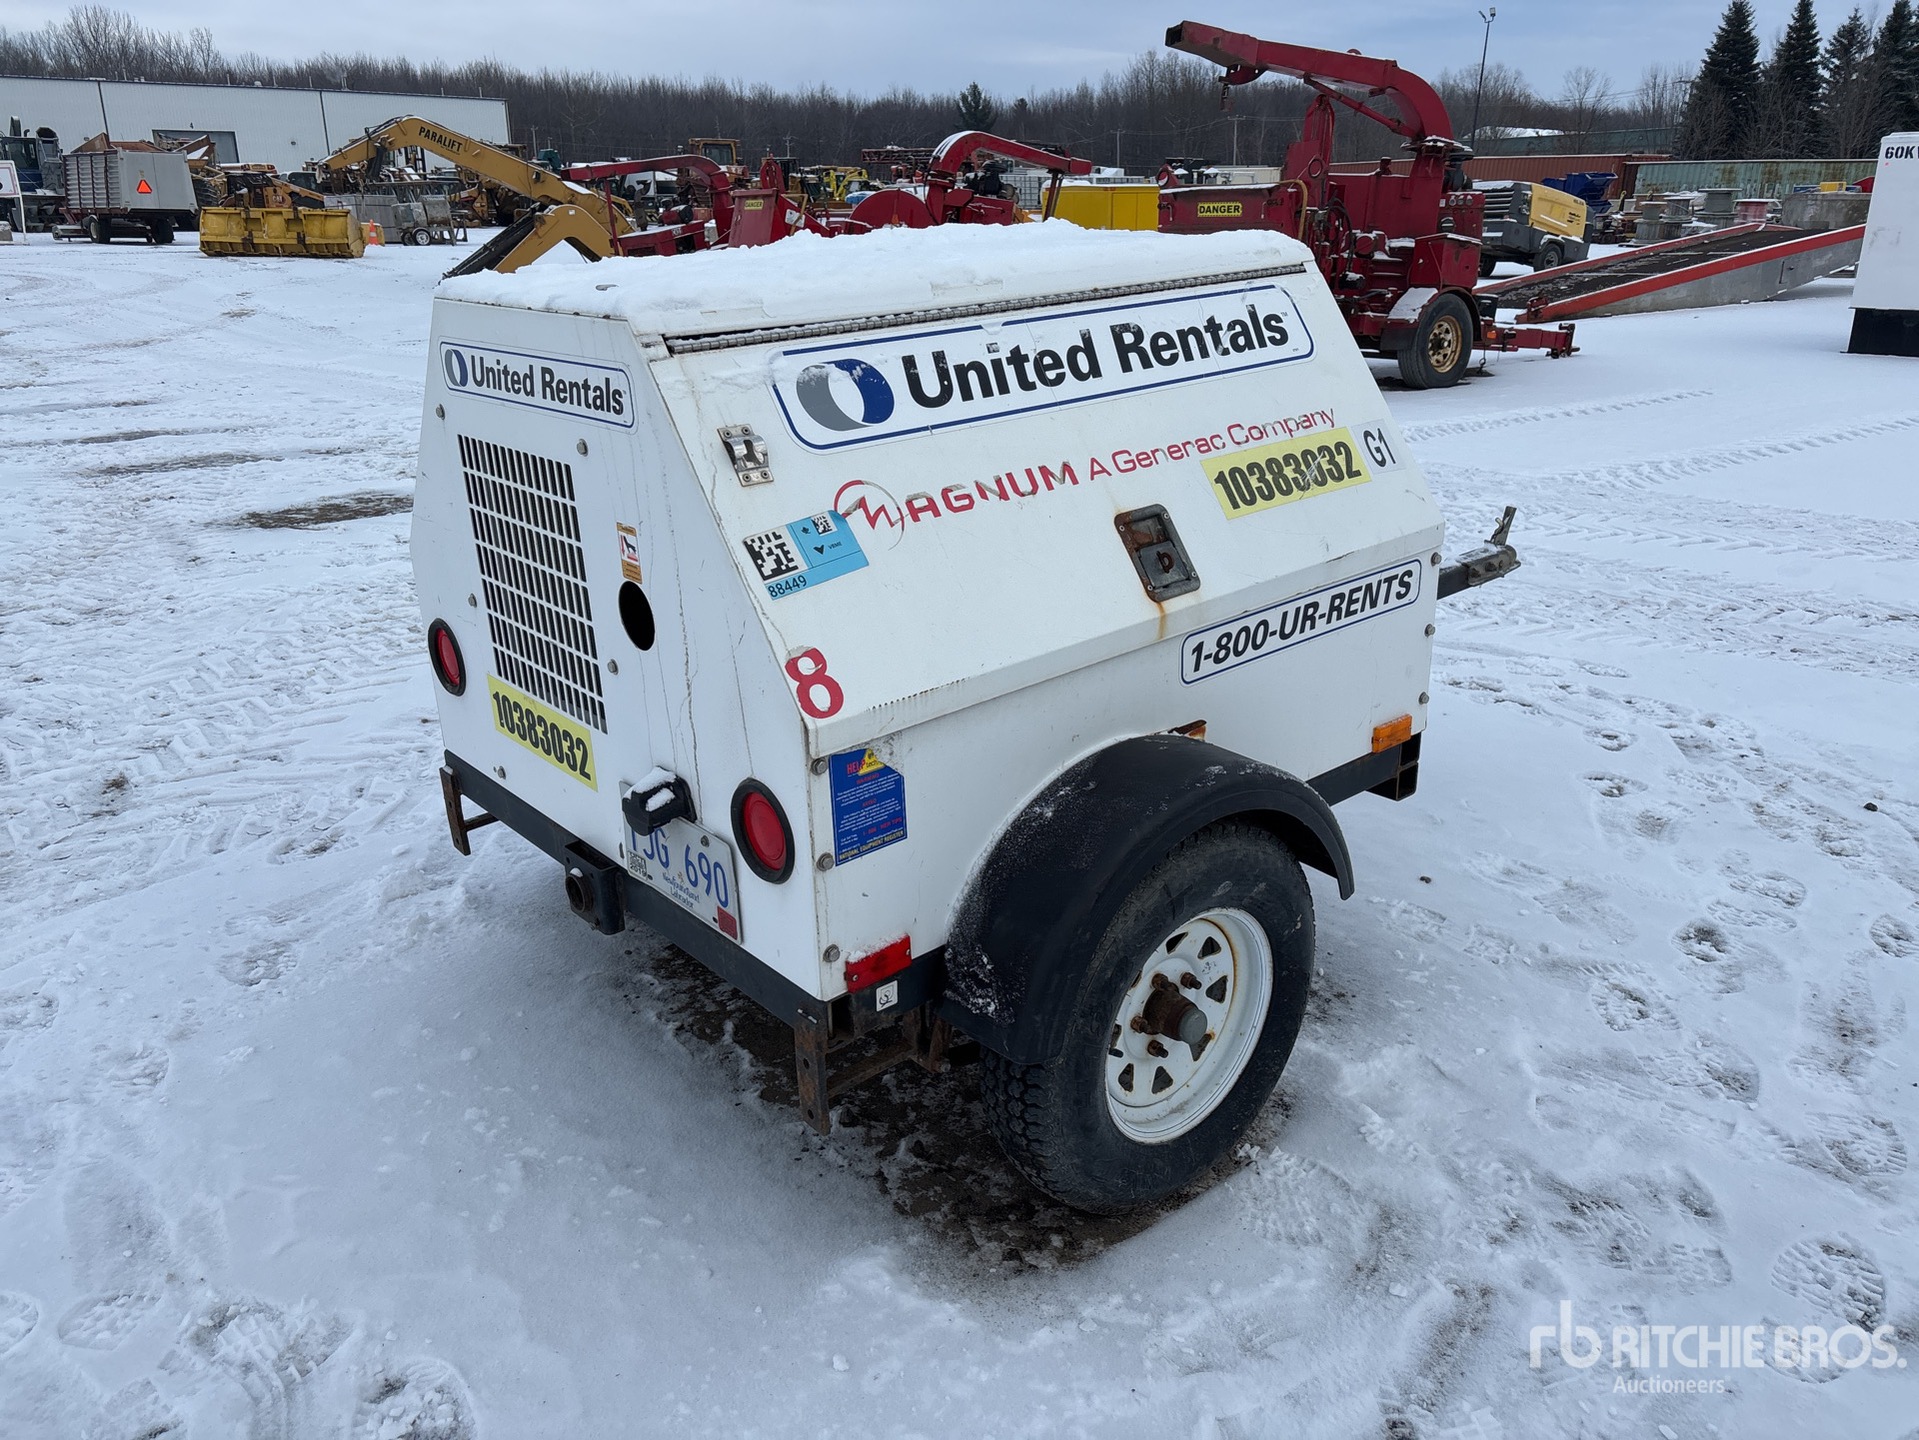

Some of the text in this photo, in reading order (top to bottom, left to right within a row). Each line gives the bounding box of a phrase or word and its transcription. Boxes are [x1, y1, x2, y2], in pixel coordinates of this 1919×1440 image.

[419, 126, 463, 152] PARALIFT
[1885, 146, 1919, 159] 60K
[745, 200, 763, 209] DANGER
[1199, 205, 1241, 214] DANGER
[471, 355, 624, 416] United Rentals
[901, 304, 1290, 410] United Rentals
[1090, 457, 1113, 481] A
[1111, 433, 1226, 474] Generac
[1226, 408, 1335, 448] Company
[1213, 441, 1363, 511] 10383032
[1363, 427, 1397, 468] G1
[767, 575, 807, 598] 88449
[1191, 569, 1413, 673] 1-800-UR-RENTS
[784, 645, 844, 719] 8
[493, 691, 591, 781] 10383032
[684, 843, 729, 909] 690
